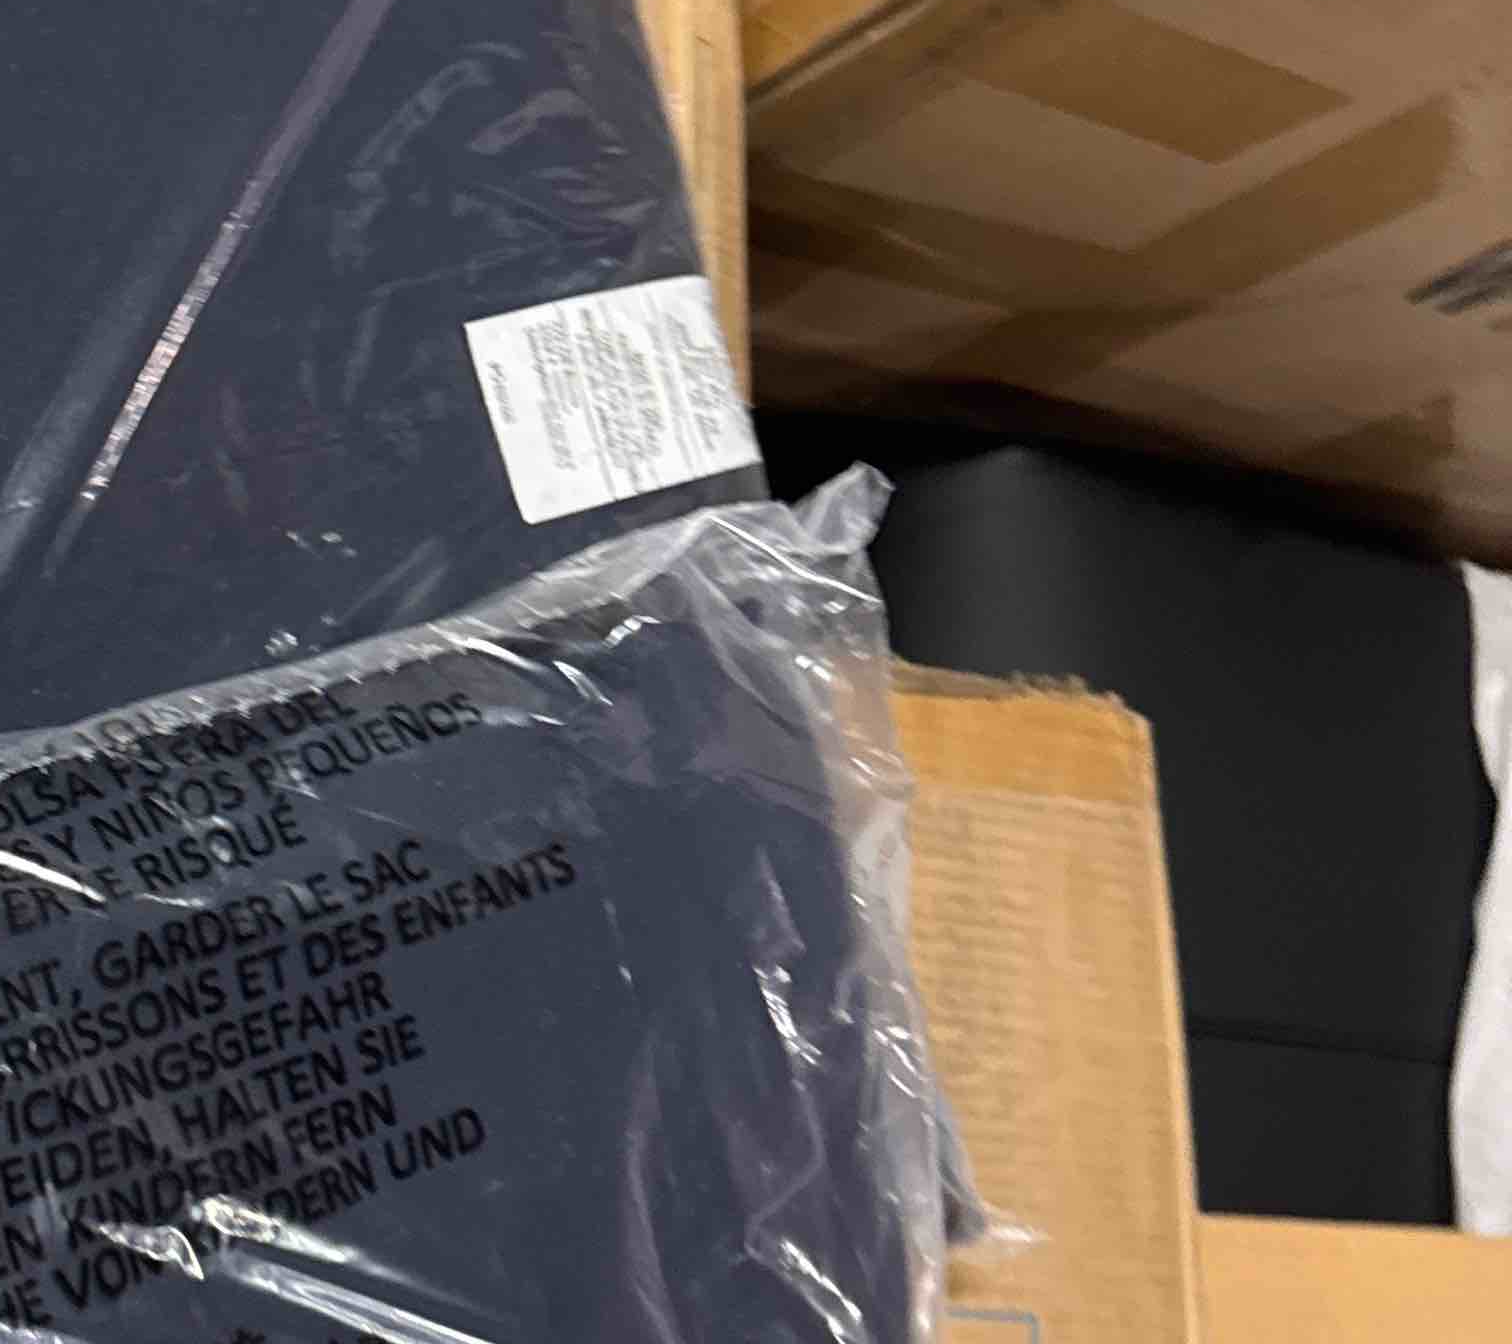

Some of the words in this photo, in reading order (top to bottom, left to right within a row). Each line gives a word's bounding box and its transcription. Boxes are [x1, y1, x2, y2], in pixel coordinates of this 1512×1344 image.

[42, 825, 80, 870] Y
[90, 769, 245, 852] NIÑOS
[249, 690, 482, 797] PEQUEÑOS
[266, 686, 358, 735] DEL
[94, 895, 285, 987] GARDER
[287, 871, 344, 923] LE
[345, 840, 432, 905] SAC
[236, 947, 289, 1002] ET
[306, 914, 387, 979] DES
[393, 843, 578, 946] ENFANTS
[170, 1038, 349, 1147] HALTEN
[358, 1013, 426, 1078] SIE
[389, 1107, 487, 1183] UND
[64, 1135, 281, 1251] KINDERN
[284, 1084, 400, 1160] FERN
